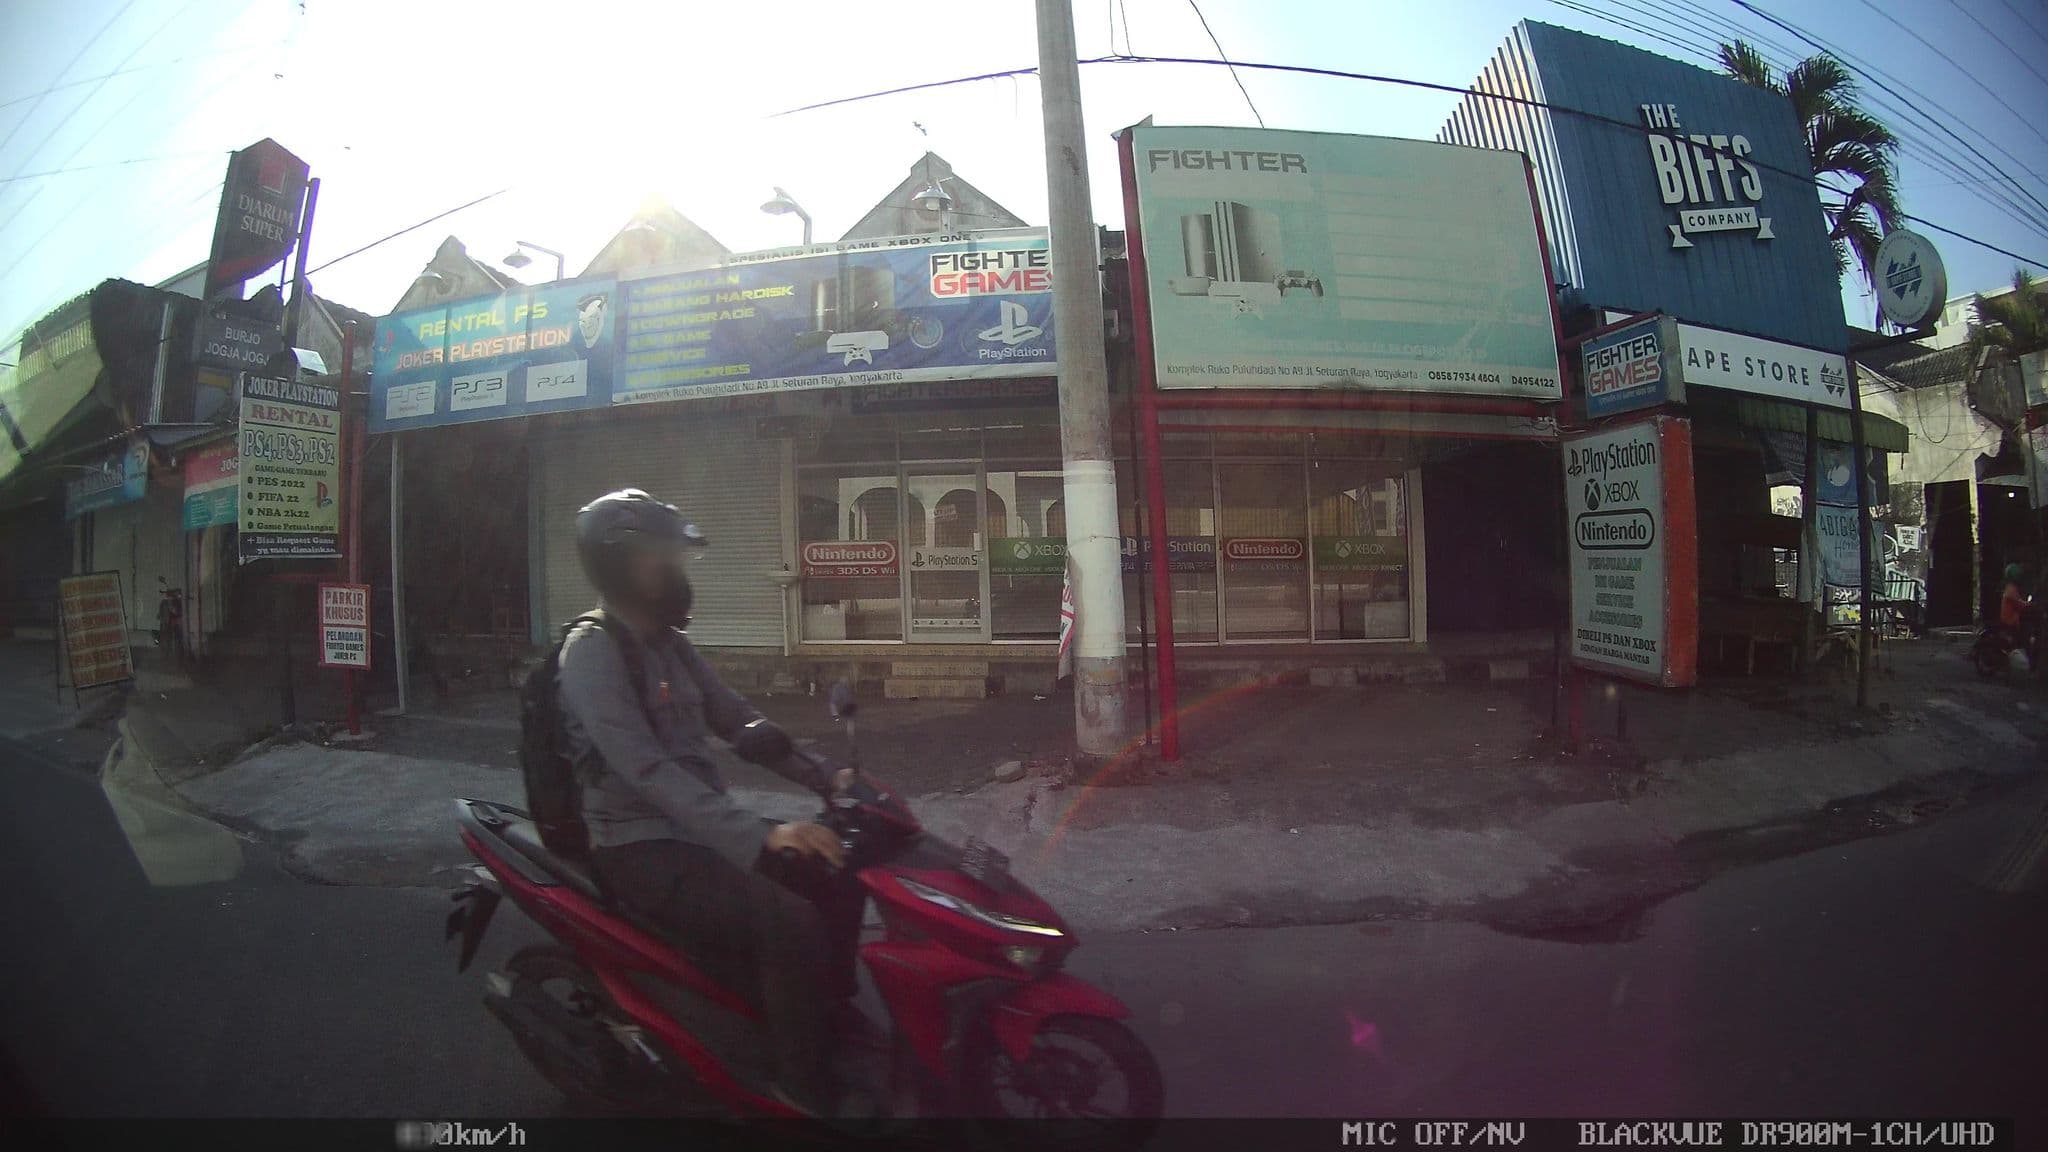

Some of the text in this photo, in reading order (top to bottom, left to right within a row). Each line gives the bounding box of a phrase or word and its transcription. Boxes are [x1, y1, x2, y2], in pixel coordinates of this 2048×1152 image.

[1641, 103, 1681, 129] THE
[1147, 148, 1308, 174] FIGHTER
[1648, 134, 1763, 205] BIFFS
[238, 194, 294, 227] DJARUM
[1688, 212, 1752, 227] COMPANY
[240, 215, 285, 242] SUPER
[836, 240, 880, 252] GAME
[888, 236, 931, 246] XBOX
[940, 231, 972, 243] ONE
[932, 248, 1049, 274] FIGHTE
[716, 284, 795, 304] HARDISK
[419, 301, 550, 342] RENTAL PS
[225, 327, 261, 345] BURJO
[205, 341, 240, 360] JOGJA
[395, 325, 572, 370] JOKER PLAYSTATION
[978, 344, 1047, 360] PlayStation
[1586, 333, 1659, 373] FIGHTER
[1167, 364, 1206, 377] Komplek
[1207, 364, 1230, 375] Ruko
[1315, 366, 1348, 377] Seturan
[1590, 355, 1660, 393] GAMES
[1745, 356, 1811, 386] STORE
[248, 377, 340, 408] JOKER PLAYSTATION
[454, 377, 503, 395] PS3
[536, 374, 577, 388] PS4
[782, 376, 819, 388] Seturan
[252, 404, 334, 428] RENTAL
[1582, 438, 1657, 480] PlayStation
[256, 476, 306, 488] PES 2022
[1603, 480, 1641, 504] XBOX
[257, 492, 300, 503] FIFA 22
[256, 507, 282, 517] NBA
[256, 522, 282, 531] Game
[1581, 519, 1647, 541] Nintendo
[277, 536, 311, 545] Request
[312, 536, 334, 544] Game
[811, 546, 888, 561] Nintendo
[1034, 545, 1067, 557] XBOX
[1232, 543, 1297, 556] Nintendo
[1352, 543, 1386, 555] XBOX
[837, 566, 860, 576] 3DS
[862, 566, 879, 576] DS
[1608, 576, 1635, 591] GAME
[325, 591, 364, 606] PARKIR
[325, 606, 364, 621] KHUSUS
[1577, 628, 1657, 653] DIBELI PS DAN XBOX
